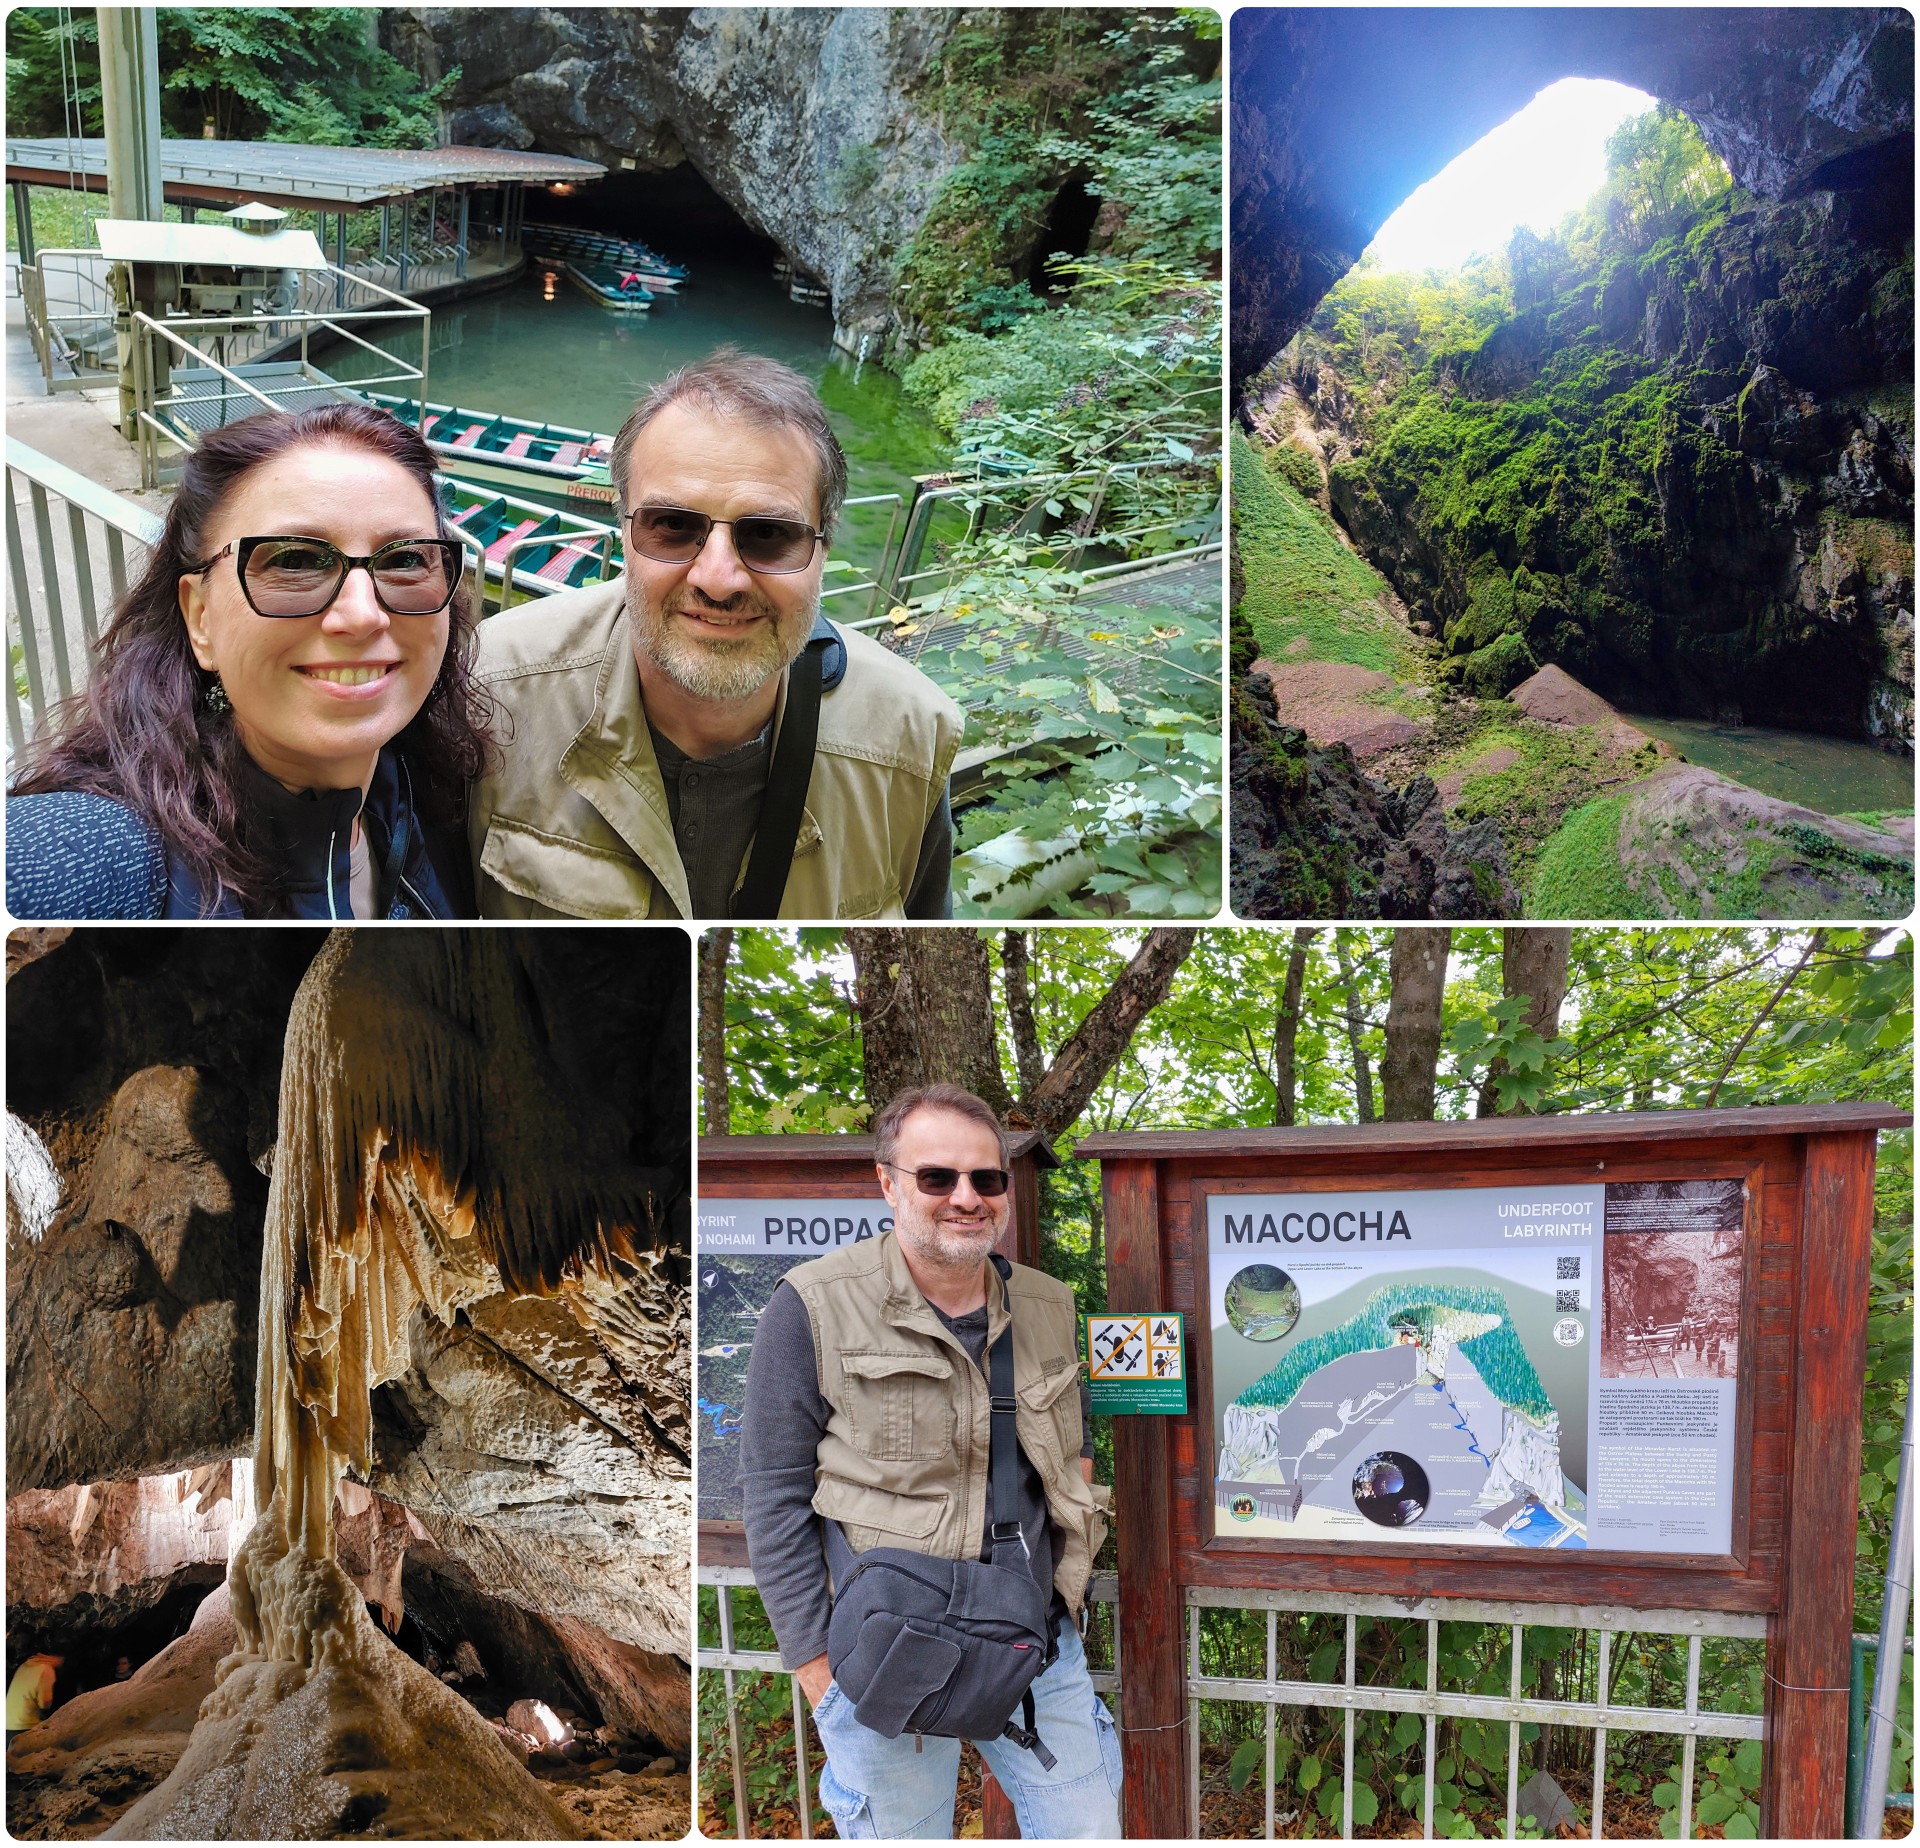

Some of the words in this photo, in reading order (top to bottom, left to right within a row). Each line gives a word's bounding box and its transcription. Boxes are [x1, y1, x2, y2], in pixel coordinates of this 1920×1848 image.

[567, 484, 615, 502] PŘEROV
[1498, 1202, 1594, 1218] UNDERFOOT
[1224, 1210, 1412, 1244] MACOCHA
[1504, 1223, 1592, 1238] LABYRINTH
[706, 1234, 756, 1245] NOHAMI
